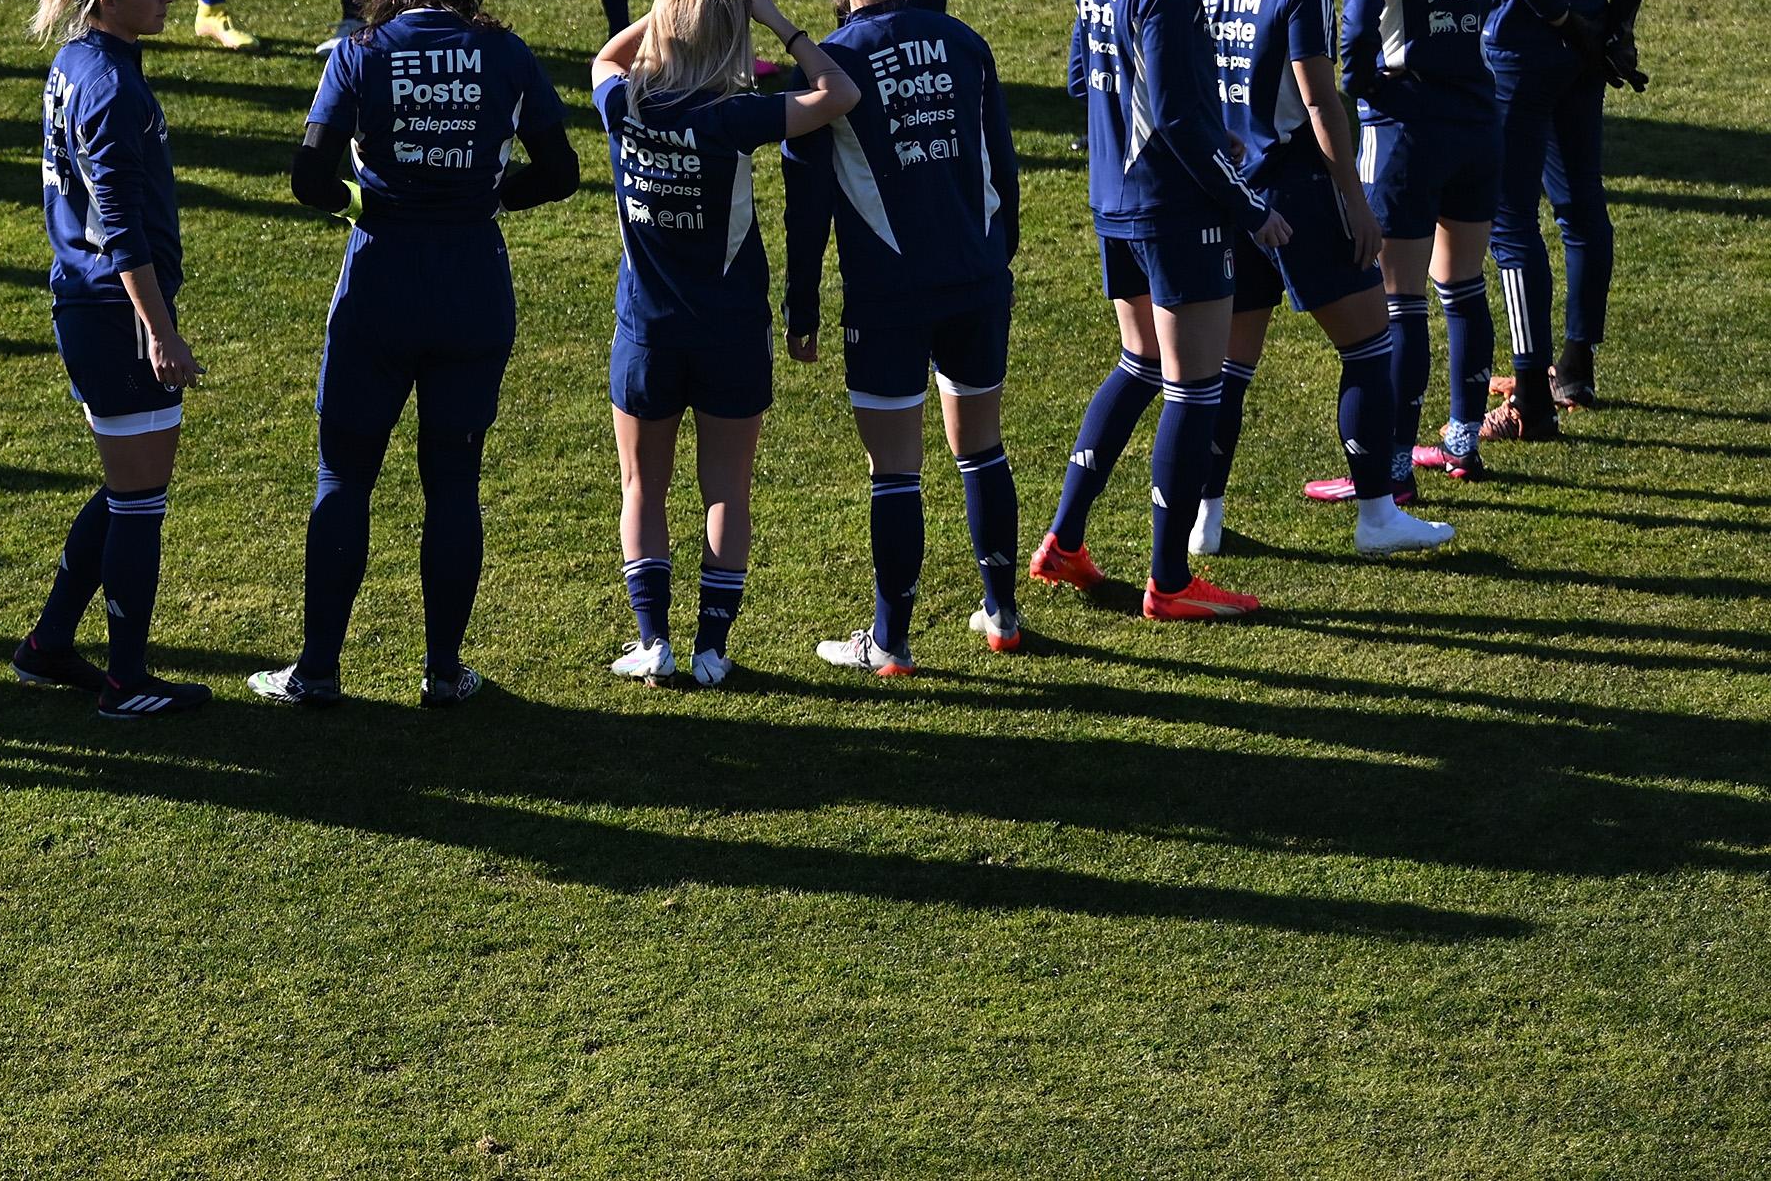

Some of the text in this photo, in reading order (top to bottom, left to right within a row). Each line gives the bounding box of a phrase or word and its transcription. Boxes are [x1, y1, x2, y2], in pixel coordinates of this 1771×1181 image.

[425, 48, 482, 74] TIM
[899, 39, 948, 66] TIM
[391, 78, 482, 105] Poste
[877, 70, 953, 106] Poste
[1091, 65, 1121, 94] eni
[408, 116, 477, 134] Telepass
[427, 140, 474, 169] eni
[620, 135, 701, 173] Poste
[633, 175, 702, 197] Telepass
[657, 204, 704, 230] eni
